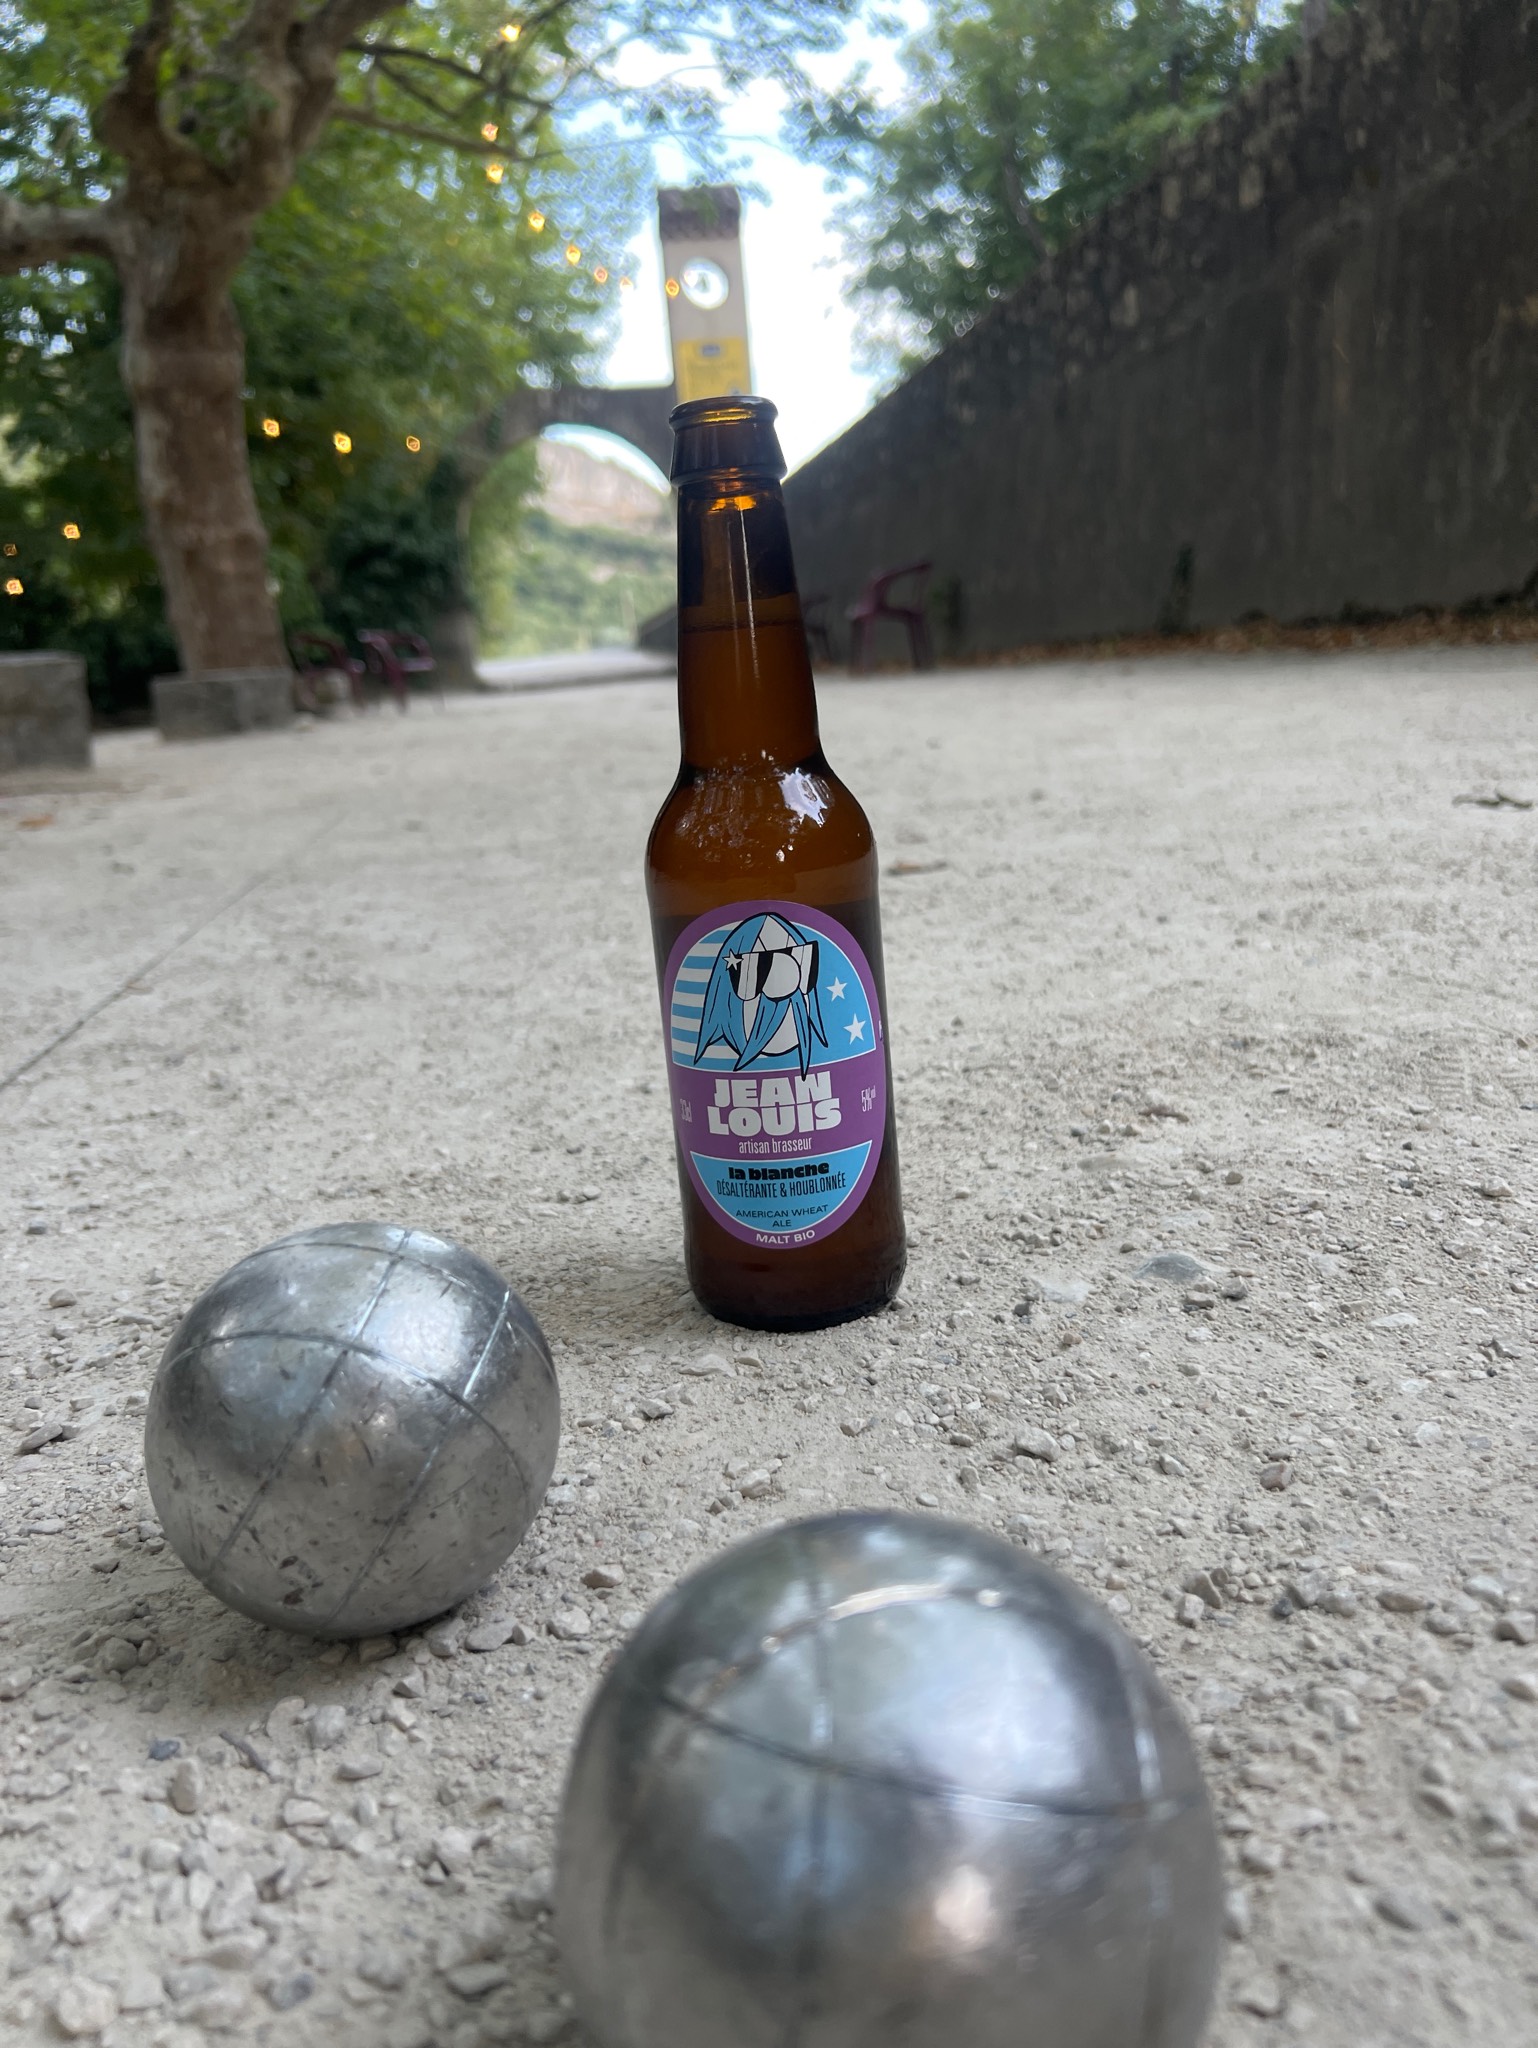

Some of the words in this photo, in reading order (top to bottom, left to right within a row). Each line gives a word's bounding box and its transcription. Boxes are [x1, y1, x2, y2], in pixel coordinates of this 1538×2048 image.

[714, 1071, 832, 1108] JEAN
[707, 1098, 842, 1136] LOUIS
[739, 1139, 770, 1154] artisan
[772, 1137, 812, 1153] brasseur
[728, 1167, 746, 1179] la
[748, 1162, 829, 1181] blanche
[717, 1180, 777, 1198] DÉSALTÉRANTE
[780, 1184, 787, 1198] &
[790, 1172, 846, 1197] HOUBLONNÉE
[735, 1210, 789, 1218] AMERICAN
[791, 1204, 829, 1216] WHEAT
[772, 1219, 792, 1228] ALE
[756, 1232, 790, 1244] MALT
[793, 1229, 815, 1243] BIO
